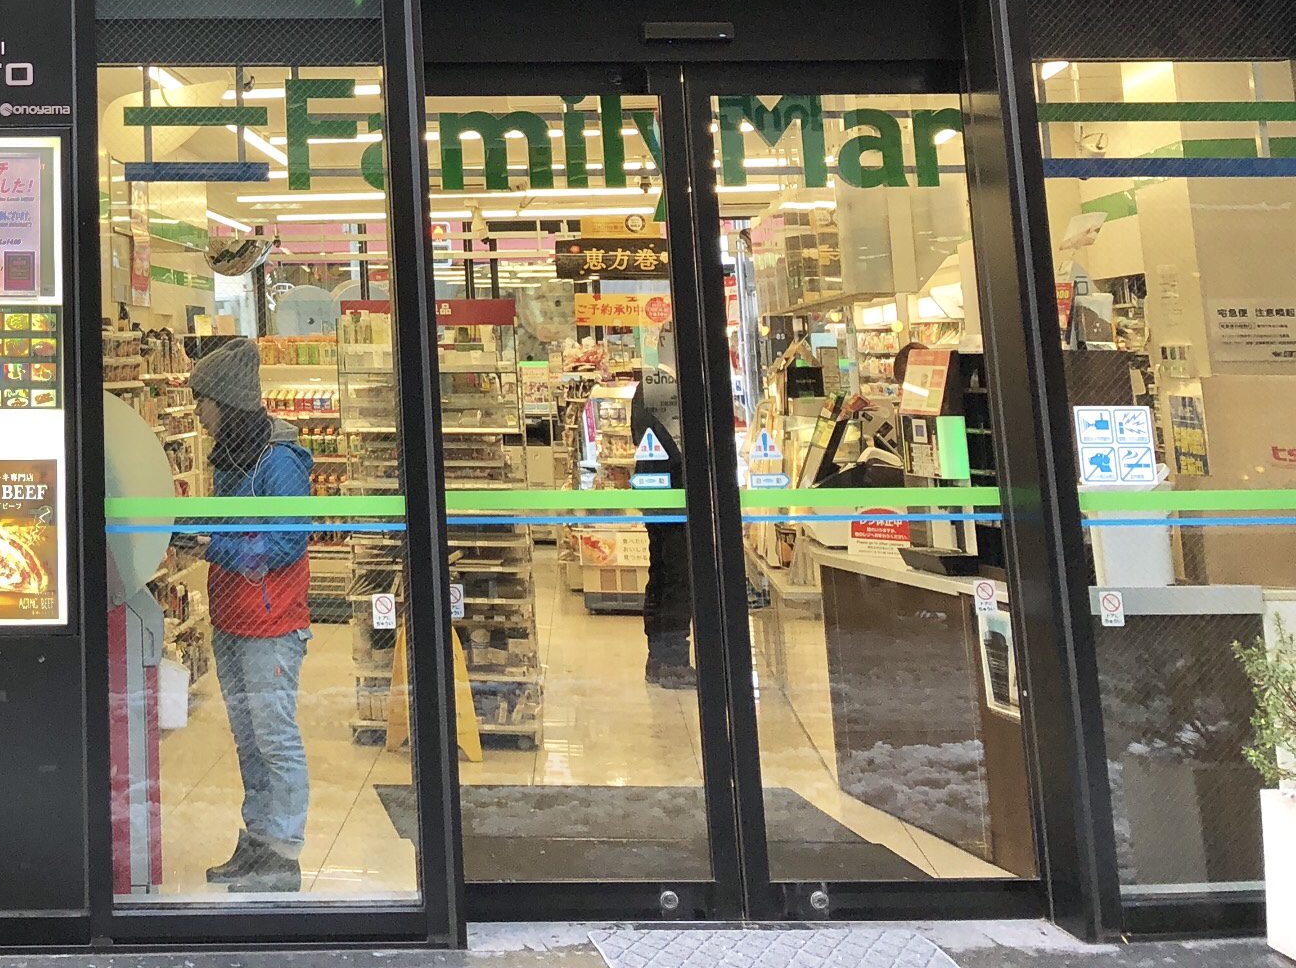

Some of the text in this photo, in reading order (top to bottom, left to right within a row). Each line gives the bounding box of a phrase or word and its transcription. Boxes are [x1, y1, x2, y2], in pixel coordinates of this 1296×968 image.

[583, 248, 660, 272] 恵方巻
[1216, 308, 1249, 318] 宅急便
[1, 484, 48, 500] BEEF
